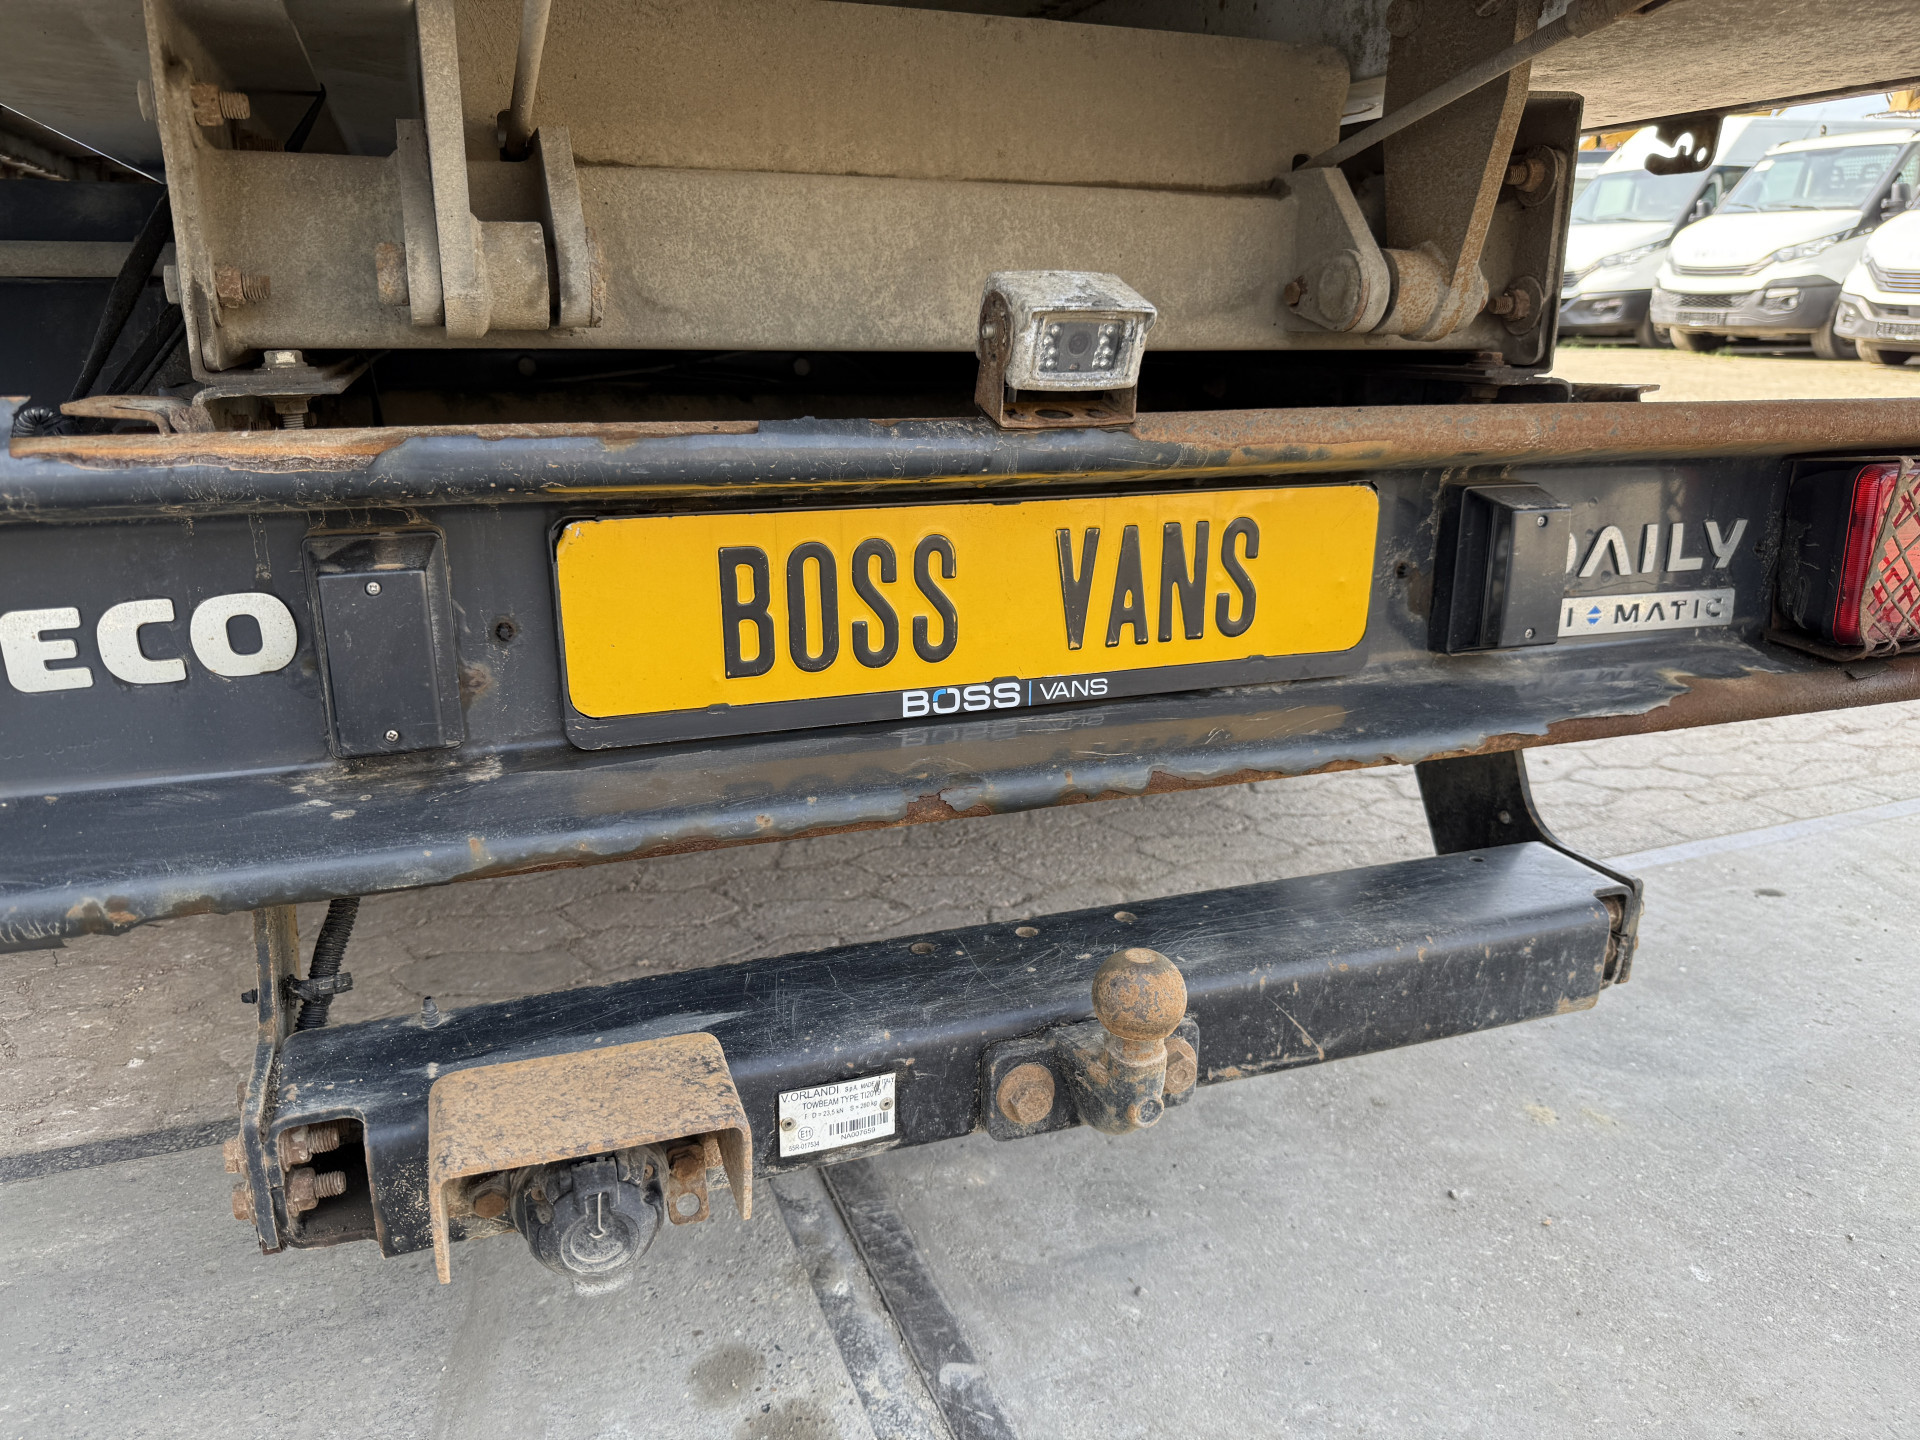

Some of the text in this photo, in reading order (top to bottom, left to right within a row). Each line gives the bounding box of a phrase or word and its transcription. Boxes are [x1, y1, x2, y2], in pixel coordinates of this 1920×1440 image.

[718, 516, 1260, 679] BOSS VANS
[1614, 597, 1723, 625] MATIC
[902, 678, 1108, 718] BOSS VANS
[860, 1080, 875, 1089] MADE
[803, 1097, 839, 1110] TOWBEAM
[841, 1093, 859, 1104] TYPE
[800, 1129, 812, 1139] E11
